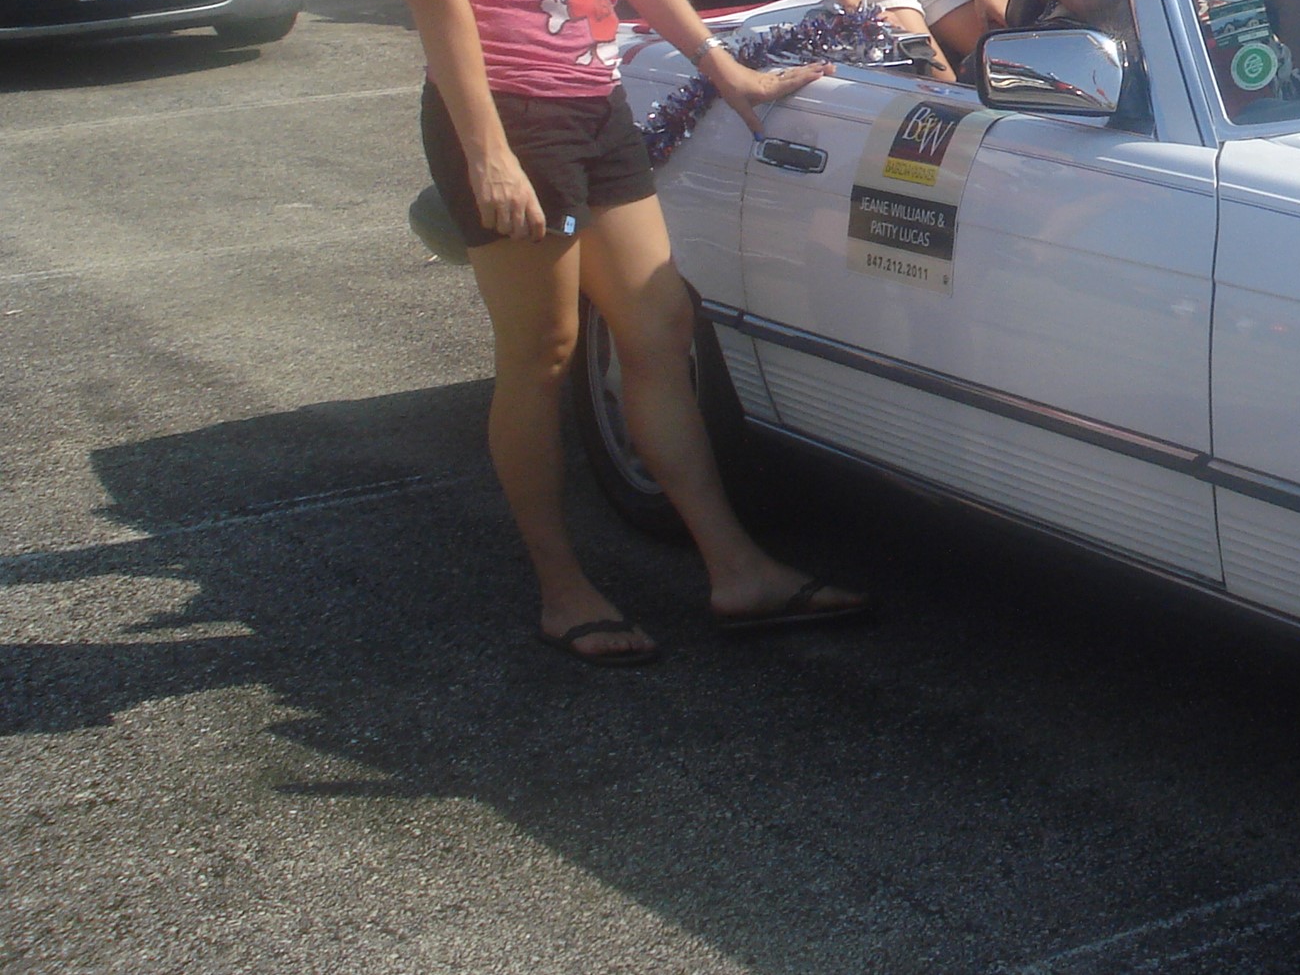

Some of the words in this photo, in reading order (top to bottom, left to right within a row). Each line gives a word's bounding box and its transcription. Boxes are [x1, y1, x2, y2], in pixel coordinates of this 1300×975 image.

[859, 196, 889, 216] JEANE
[890, 203, 936, 226] WILLIAMS
[937, 213, 945, 228] &
[870, 220, 899, 239] PATTY
[900, 226, 930, 247] LUCAS
[866, 253, 929, 281] 847.212.2011
